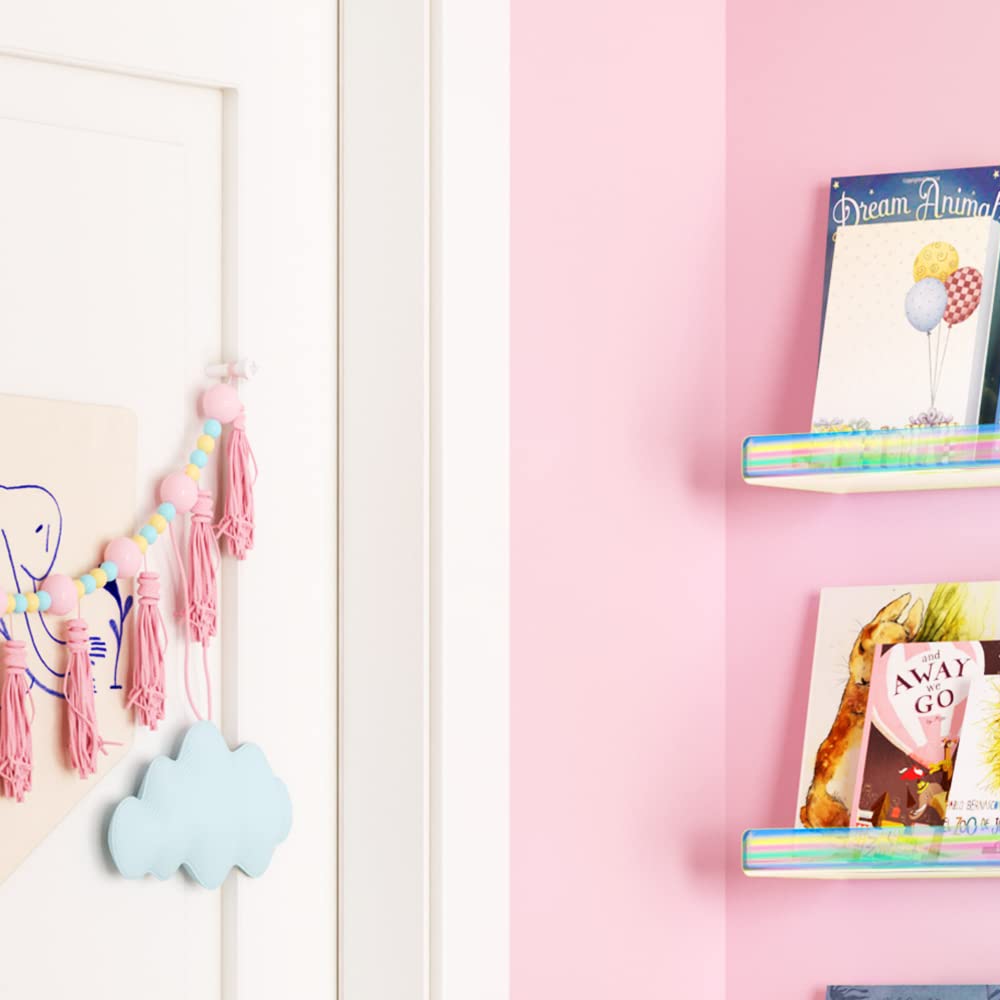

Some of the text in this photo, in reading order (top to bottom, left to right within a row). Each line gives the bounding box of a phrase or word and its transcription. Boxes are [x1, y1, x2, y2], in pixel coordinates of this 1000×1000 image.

[833, 191, 911, 226] Dream
[922, 650, 941, 663] and
[893, 657, 971, 695] AWAY
[927, 682, 941, 693] we
[914, 689, 954, 714] GO
